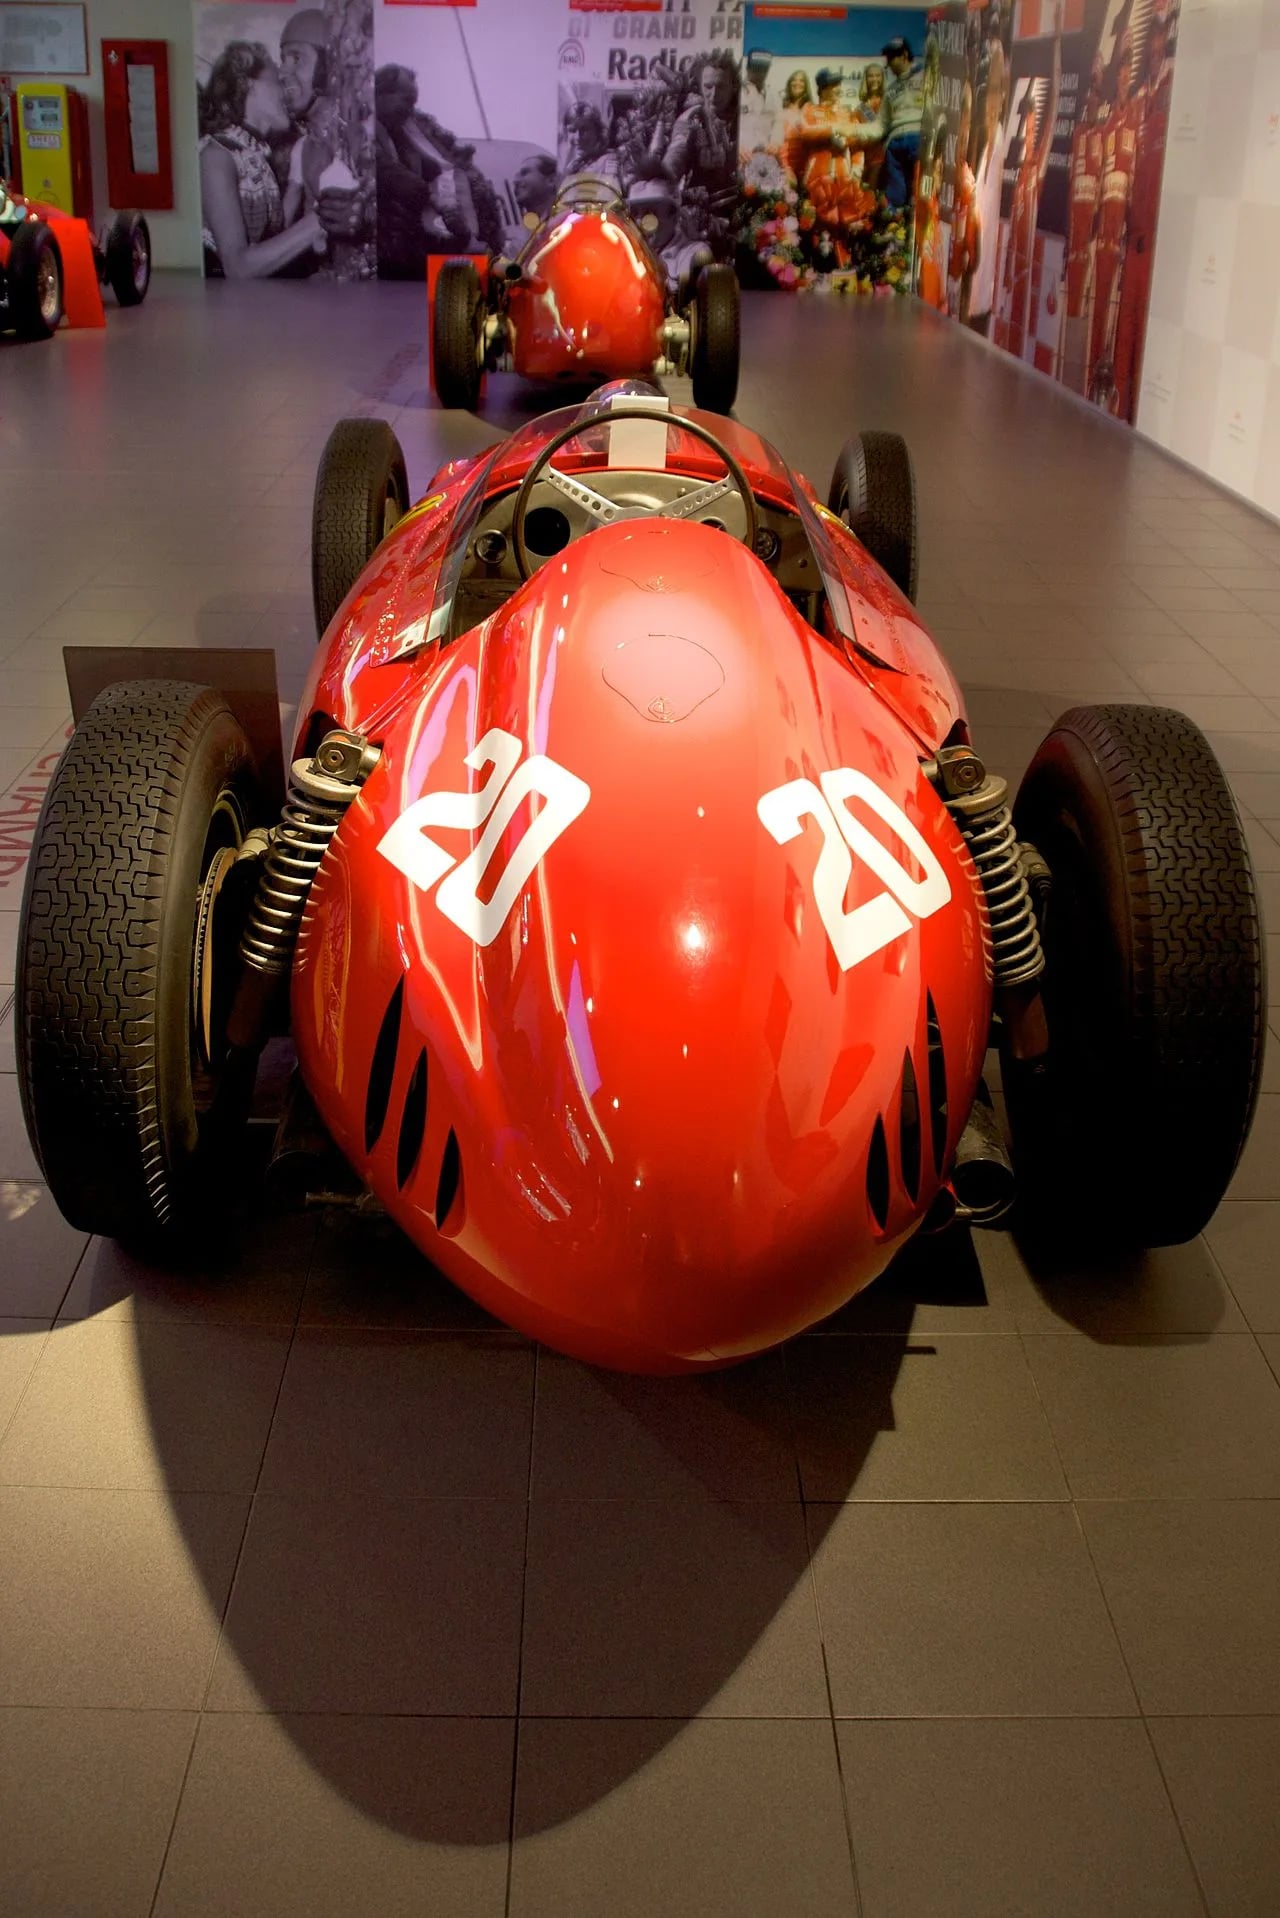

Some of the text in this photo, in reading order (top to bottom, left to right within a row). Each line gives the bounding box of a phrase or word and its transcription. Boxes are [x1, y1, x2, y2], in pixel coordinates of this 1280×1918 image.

[613, 16, 696, 39] GRAND
[376, 727, 591, 947] 20
[757, 767, 952, 972] 20
